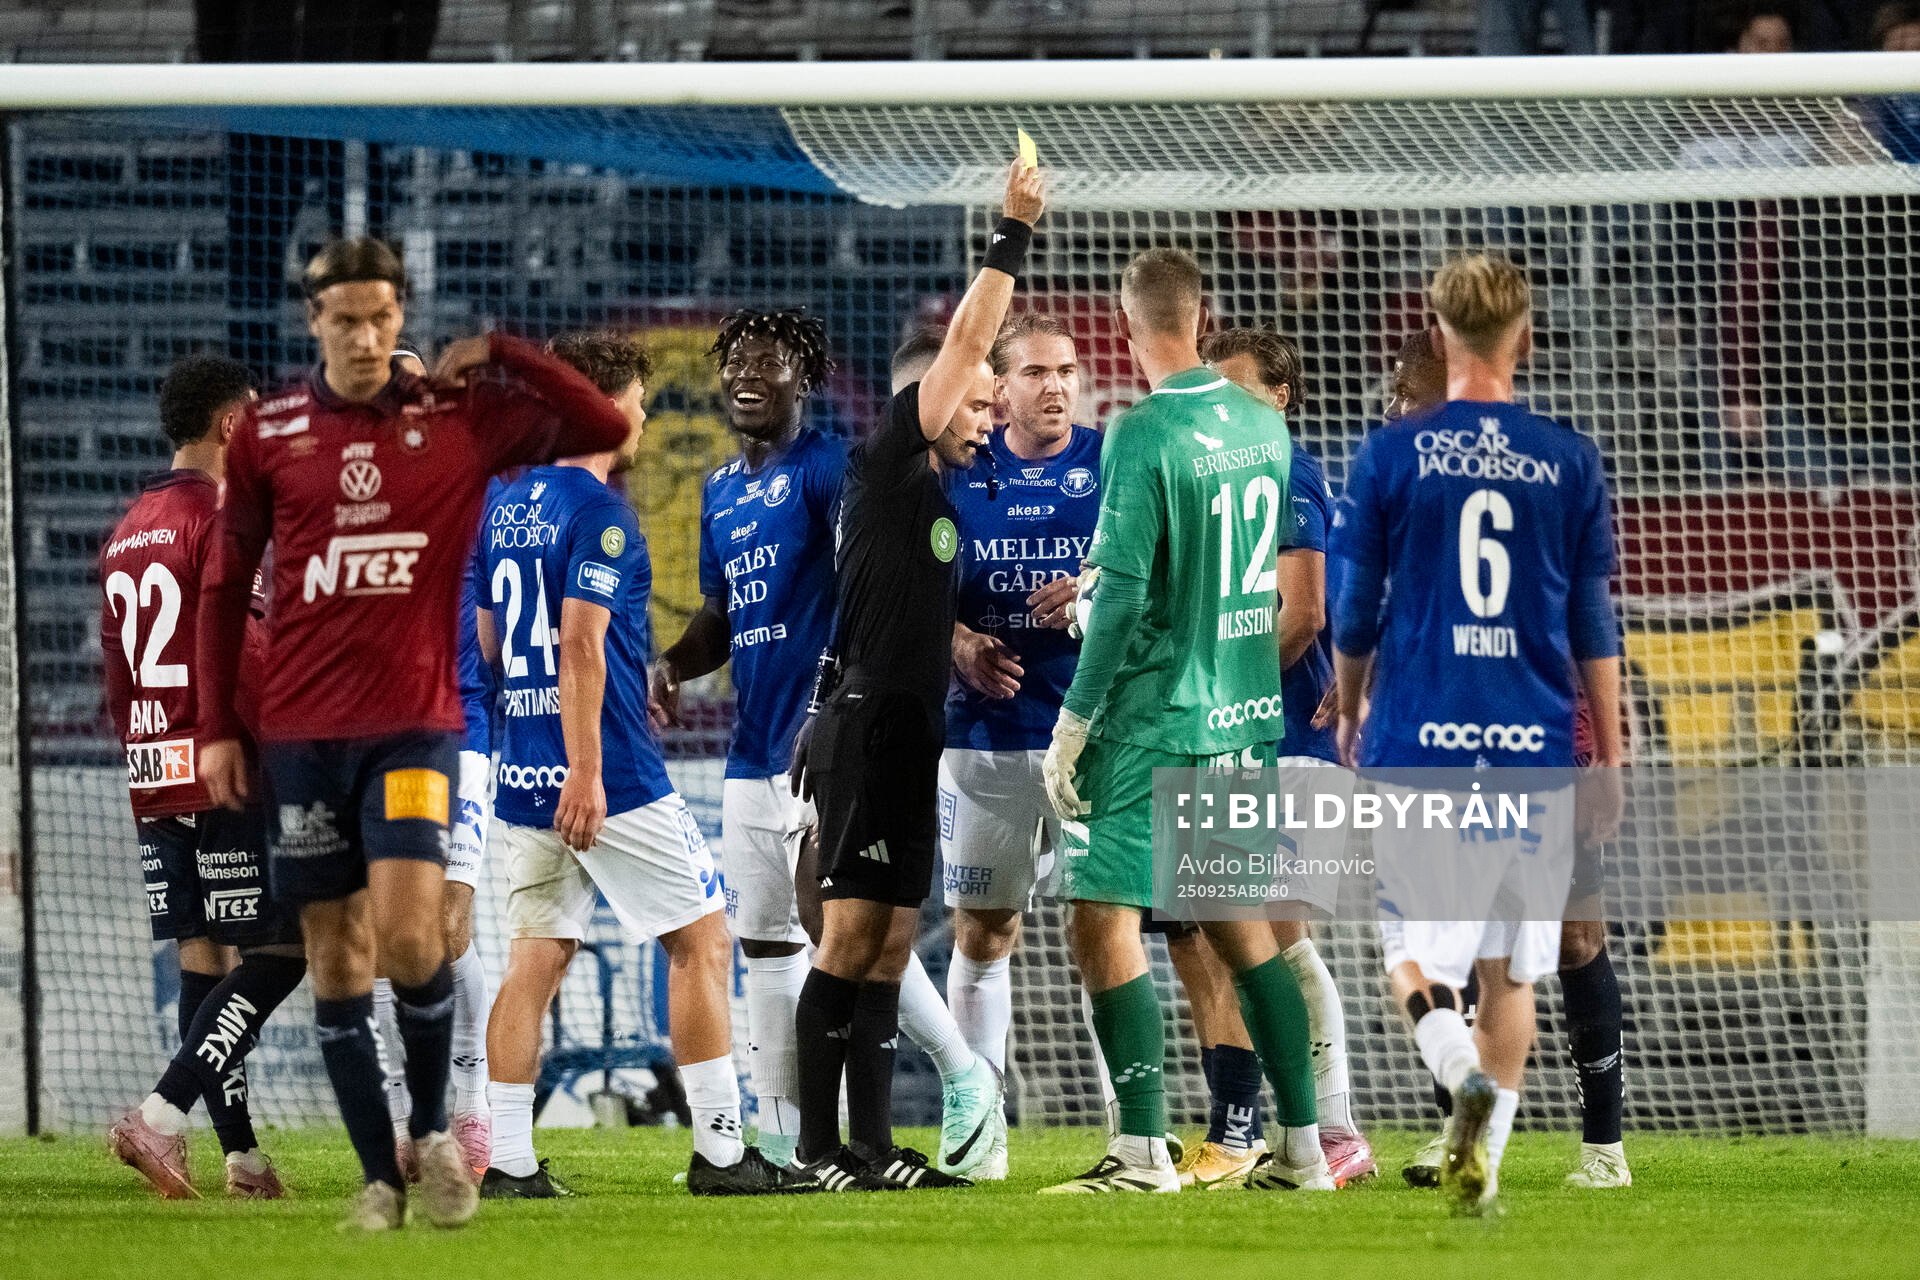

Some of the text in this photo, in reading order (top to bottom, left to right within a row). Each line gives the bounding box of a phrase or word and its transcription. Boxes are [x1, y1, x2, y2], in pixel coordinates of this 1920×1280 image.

[1192, 441, 1283, 477] ERIKSBERG
[1414, 430, 1530, 458] OSCAR
[1009, 478, 1056, 487] TRELLEBORG
[1418, 452, 1561, 487] JACOBSON
[1007, 504, 1040, 516] akea
[974, 537, 1090, 561] MELLBY
[1211, 475, 1279, 599] 12
[1459, 489, 1514, 618] 6
[584, 567, 620, 588] UNIBET
[106, 562, 189, 687] 22
[492, 558, 560, 678] 24
[1218, 605, 1273, 640] NILSSON
[198, 863, 259, 880] Månsson
[945, 862, 992, 880] INTER
[945, 878, 991, 895] SPORT
[204, 887, 262, 921] NTEX
[196, 993, 258, 1072] MIKE
